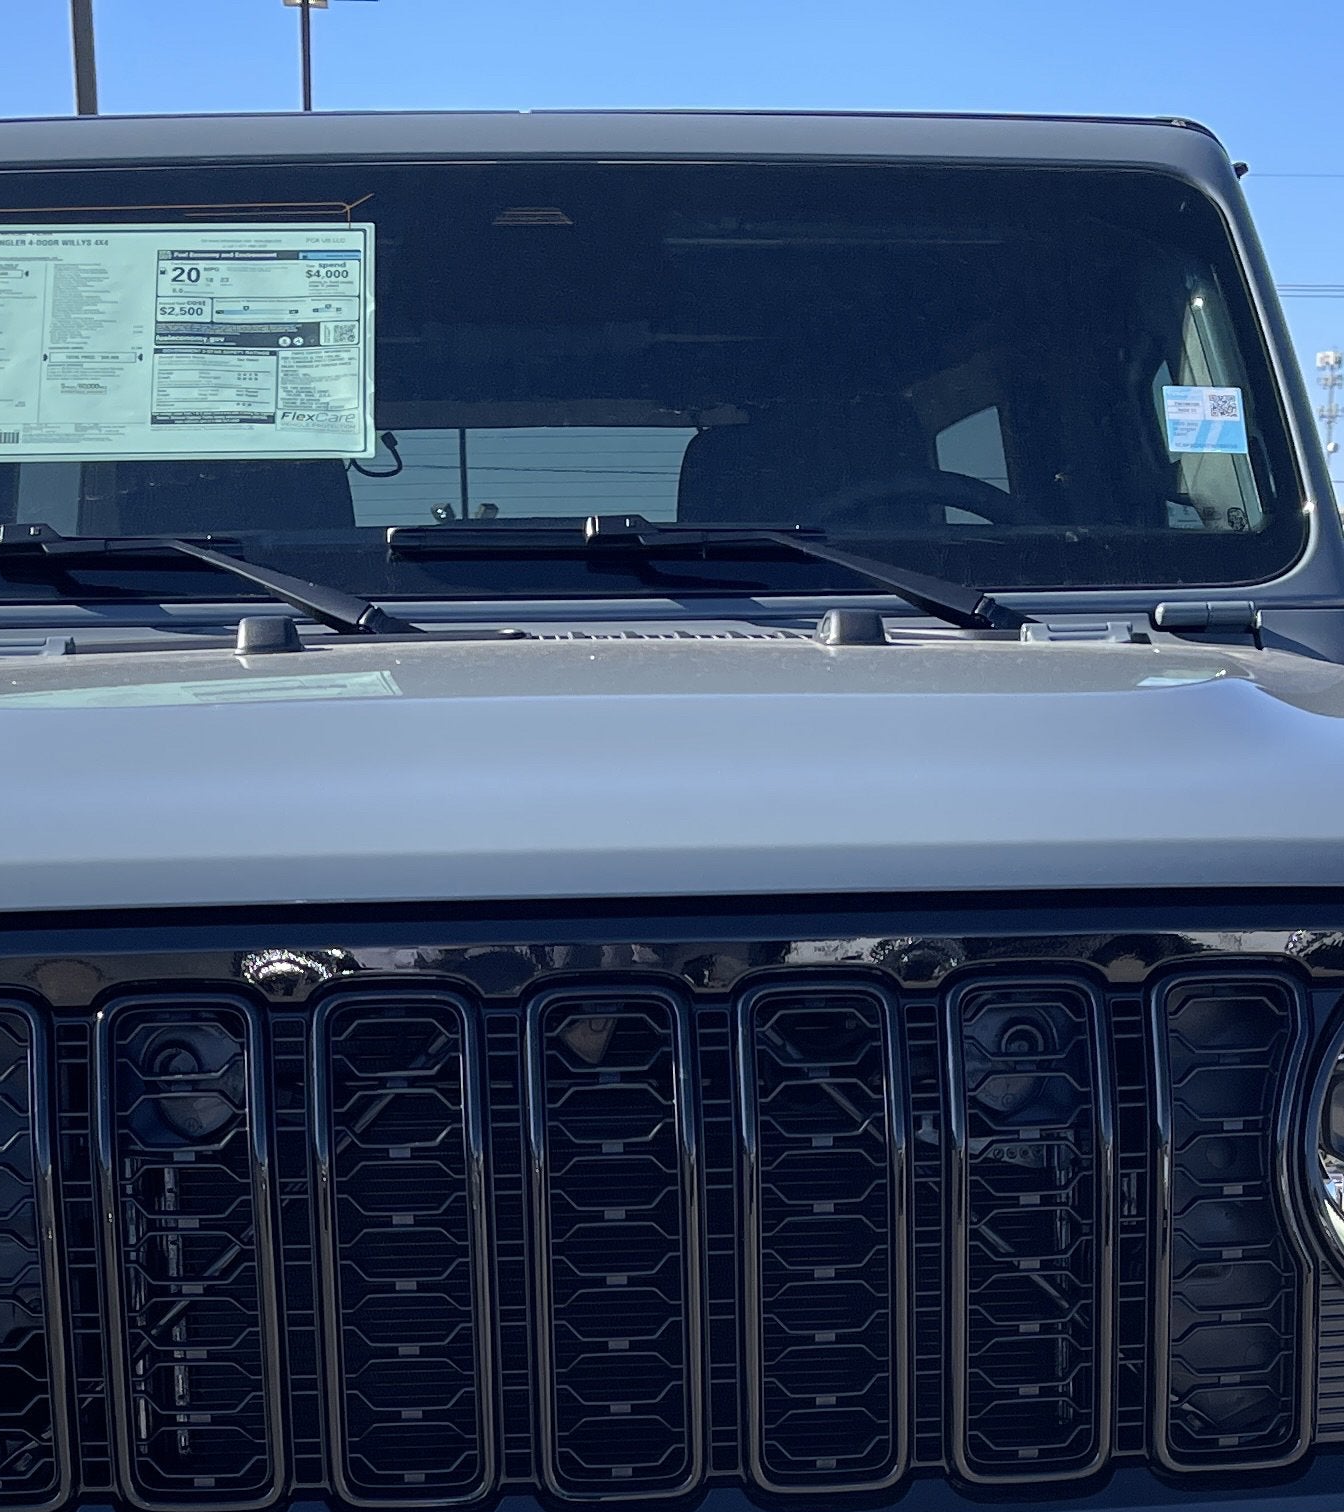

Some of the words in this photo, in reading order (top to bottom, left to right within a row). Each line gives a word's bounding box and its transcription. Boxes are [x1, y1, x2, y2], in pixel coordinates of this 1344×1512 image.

[62, 239, 92, 247] WILLYS
[171, 266, 201, 283] 20
[305, 269, 349, 280] $4,000
[159, 306, 203, 317] $2,500
[281, 411, 356, 423] FlexCare
